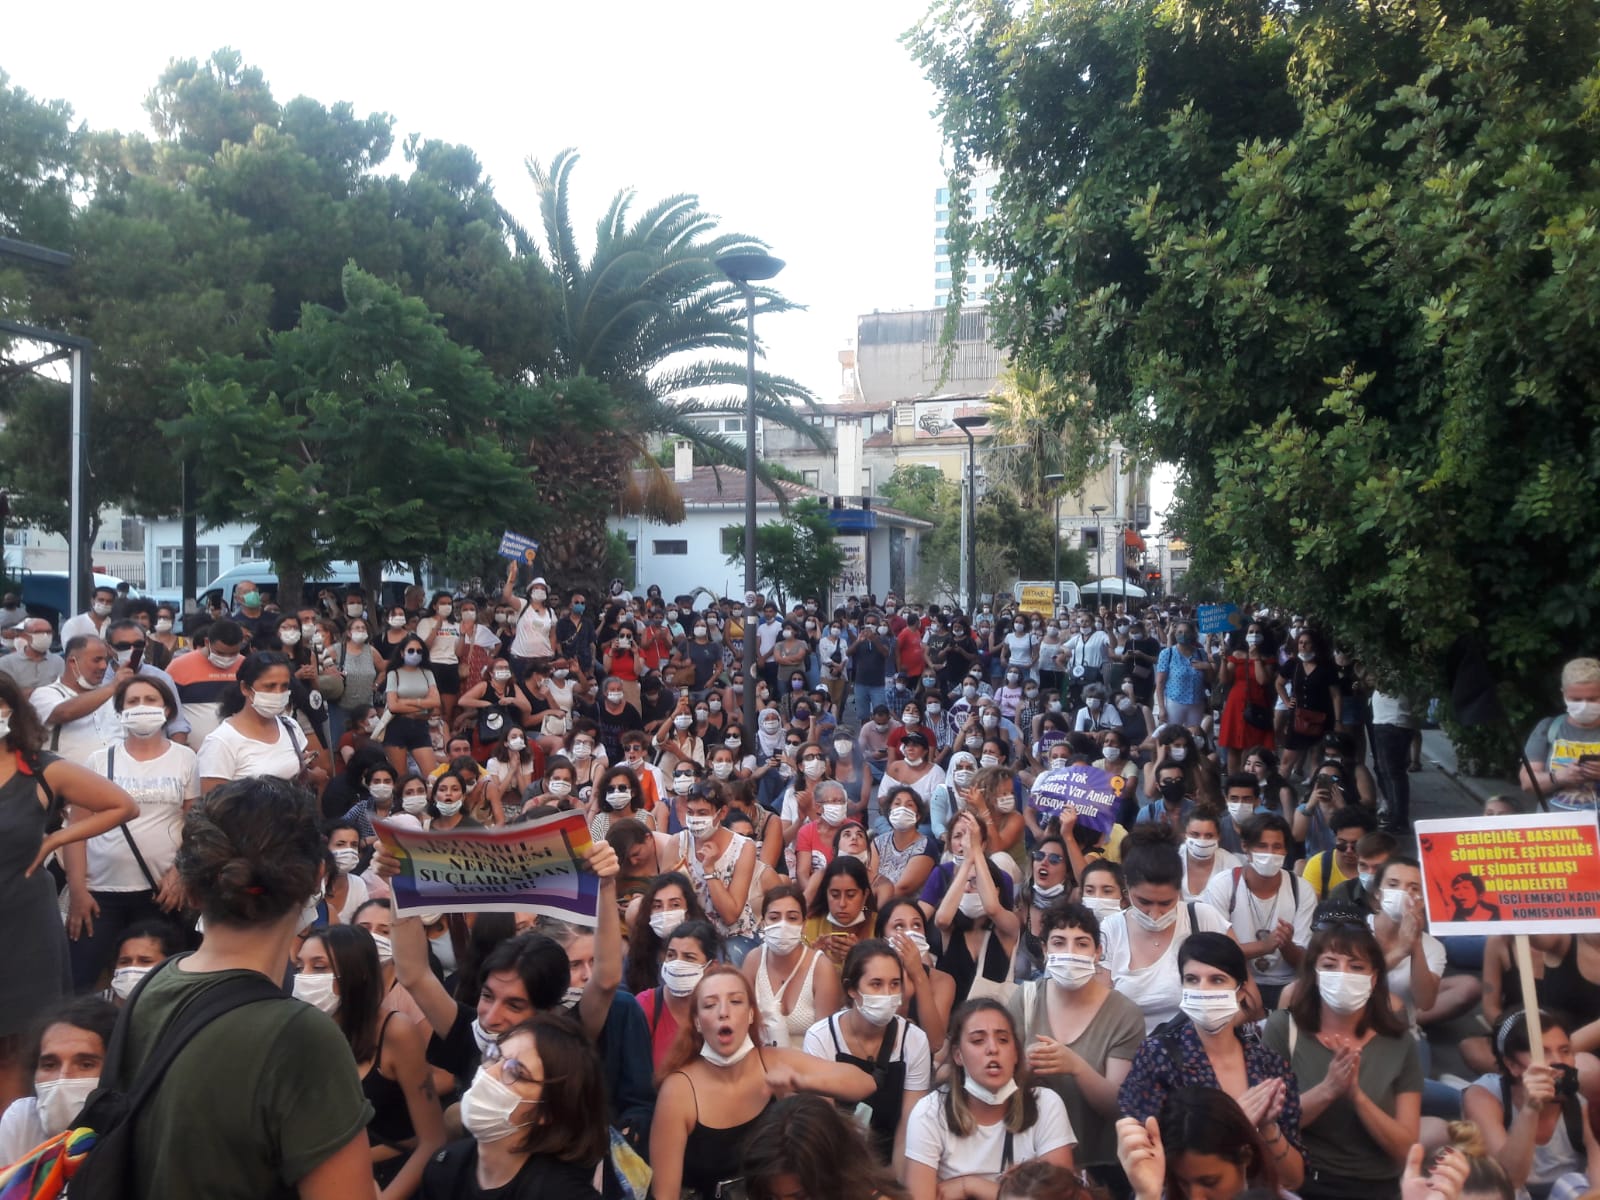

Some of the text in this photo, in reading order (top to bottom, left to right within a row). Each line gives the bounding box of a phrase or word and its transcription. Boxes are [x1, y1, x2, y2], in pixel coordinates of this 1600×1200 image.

[1070, 772, 1088, 785] Yok
[1068, 785, 1086, 799] Var
[1456, 828, 1583, 846] GERİCİLİĞE, BASKIYA,
[1451, 843, 1593, 861] SÖMÜRÜYE, EŞİTSİZLİĞE
[449, 856, 531, 875] NEFRET
[1470, 861, 1578, 877] VE ŞİDDETE KARŞI
[419, 865, 570, 885] SUÇLARINDAN
[454, 880, 537, 894] KORUR!
[1485, 877, 1568, 892] MÜCADELEYE!
